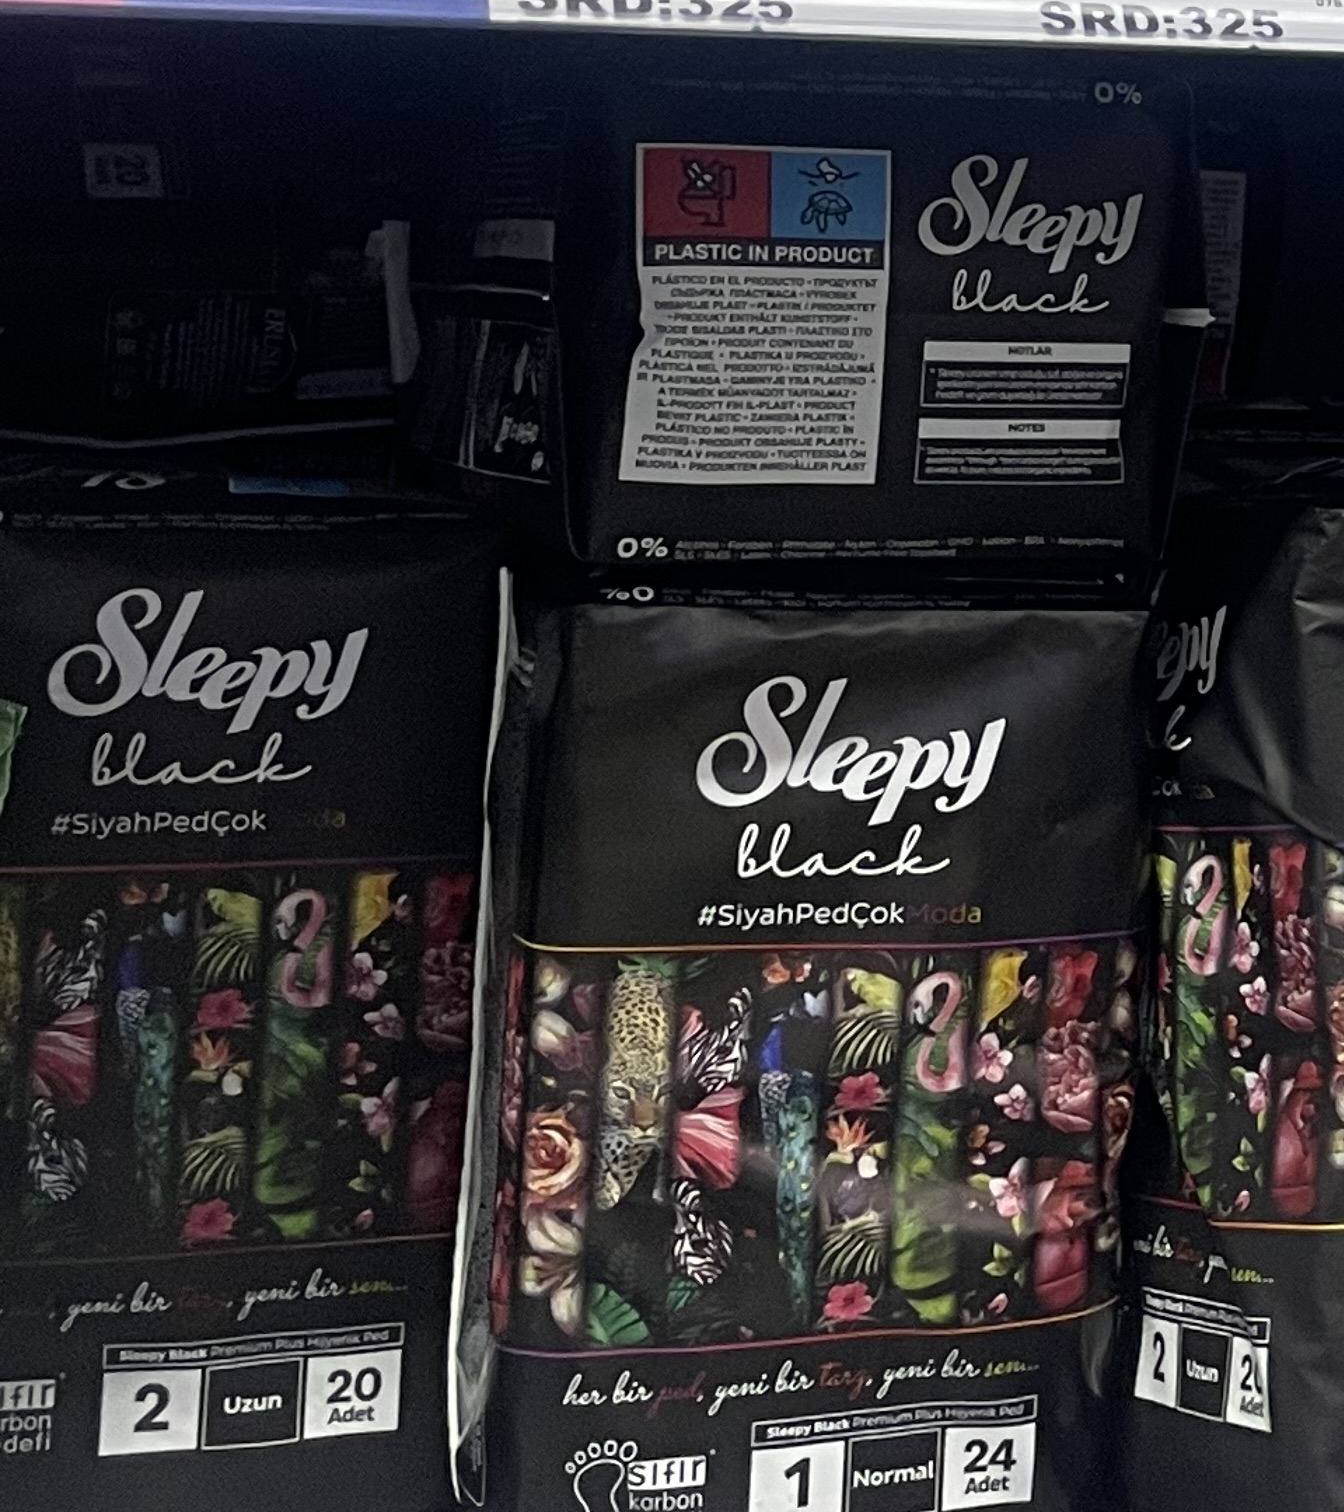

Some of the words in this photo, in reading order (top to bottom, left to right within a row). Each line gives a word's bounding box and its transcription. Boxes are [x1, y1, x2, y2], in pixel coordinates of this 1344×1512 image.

[1039, 1, 1284, 40] SRD:325
[917, 155, 1143, 273] Sleepy
[653, 243, 743, 263] PLASTIC
[748, 244, 768, 262] IN
[775, 245, 874, 265] PRODUCT
[952, 269, 1110, 315] black
[616, 536, 668, 559] 0%
[46, 588, 369, 738] Sleepy
[91, 732, 312, 788] black
[694, 675, 1006, 828] Sleepy
[736, 822, 950, 878] black
[1153, 1331, 1165, 1383] 2
[133, 1383, 171, 1433] 2
[222, 1393, 282, 1414] Uzun
[327, 1366, 382, 1404] 20
[327, 1405, 375, 1425] Adet
[767, 1423, 812, 1440] Sleepy
[814, 1418, 851, 1434] Black
[852, 1412, 913, 1430] Premium
[963, 1439, 1016, 1473] 24
[628, 1490, 704, 1512] karbon
[783, 1457, 810, 1508] 1
[852, 1461, 935, 1488] Normal
[964, 1475, 1010, 1495] Adet
